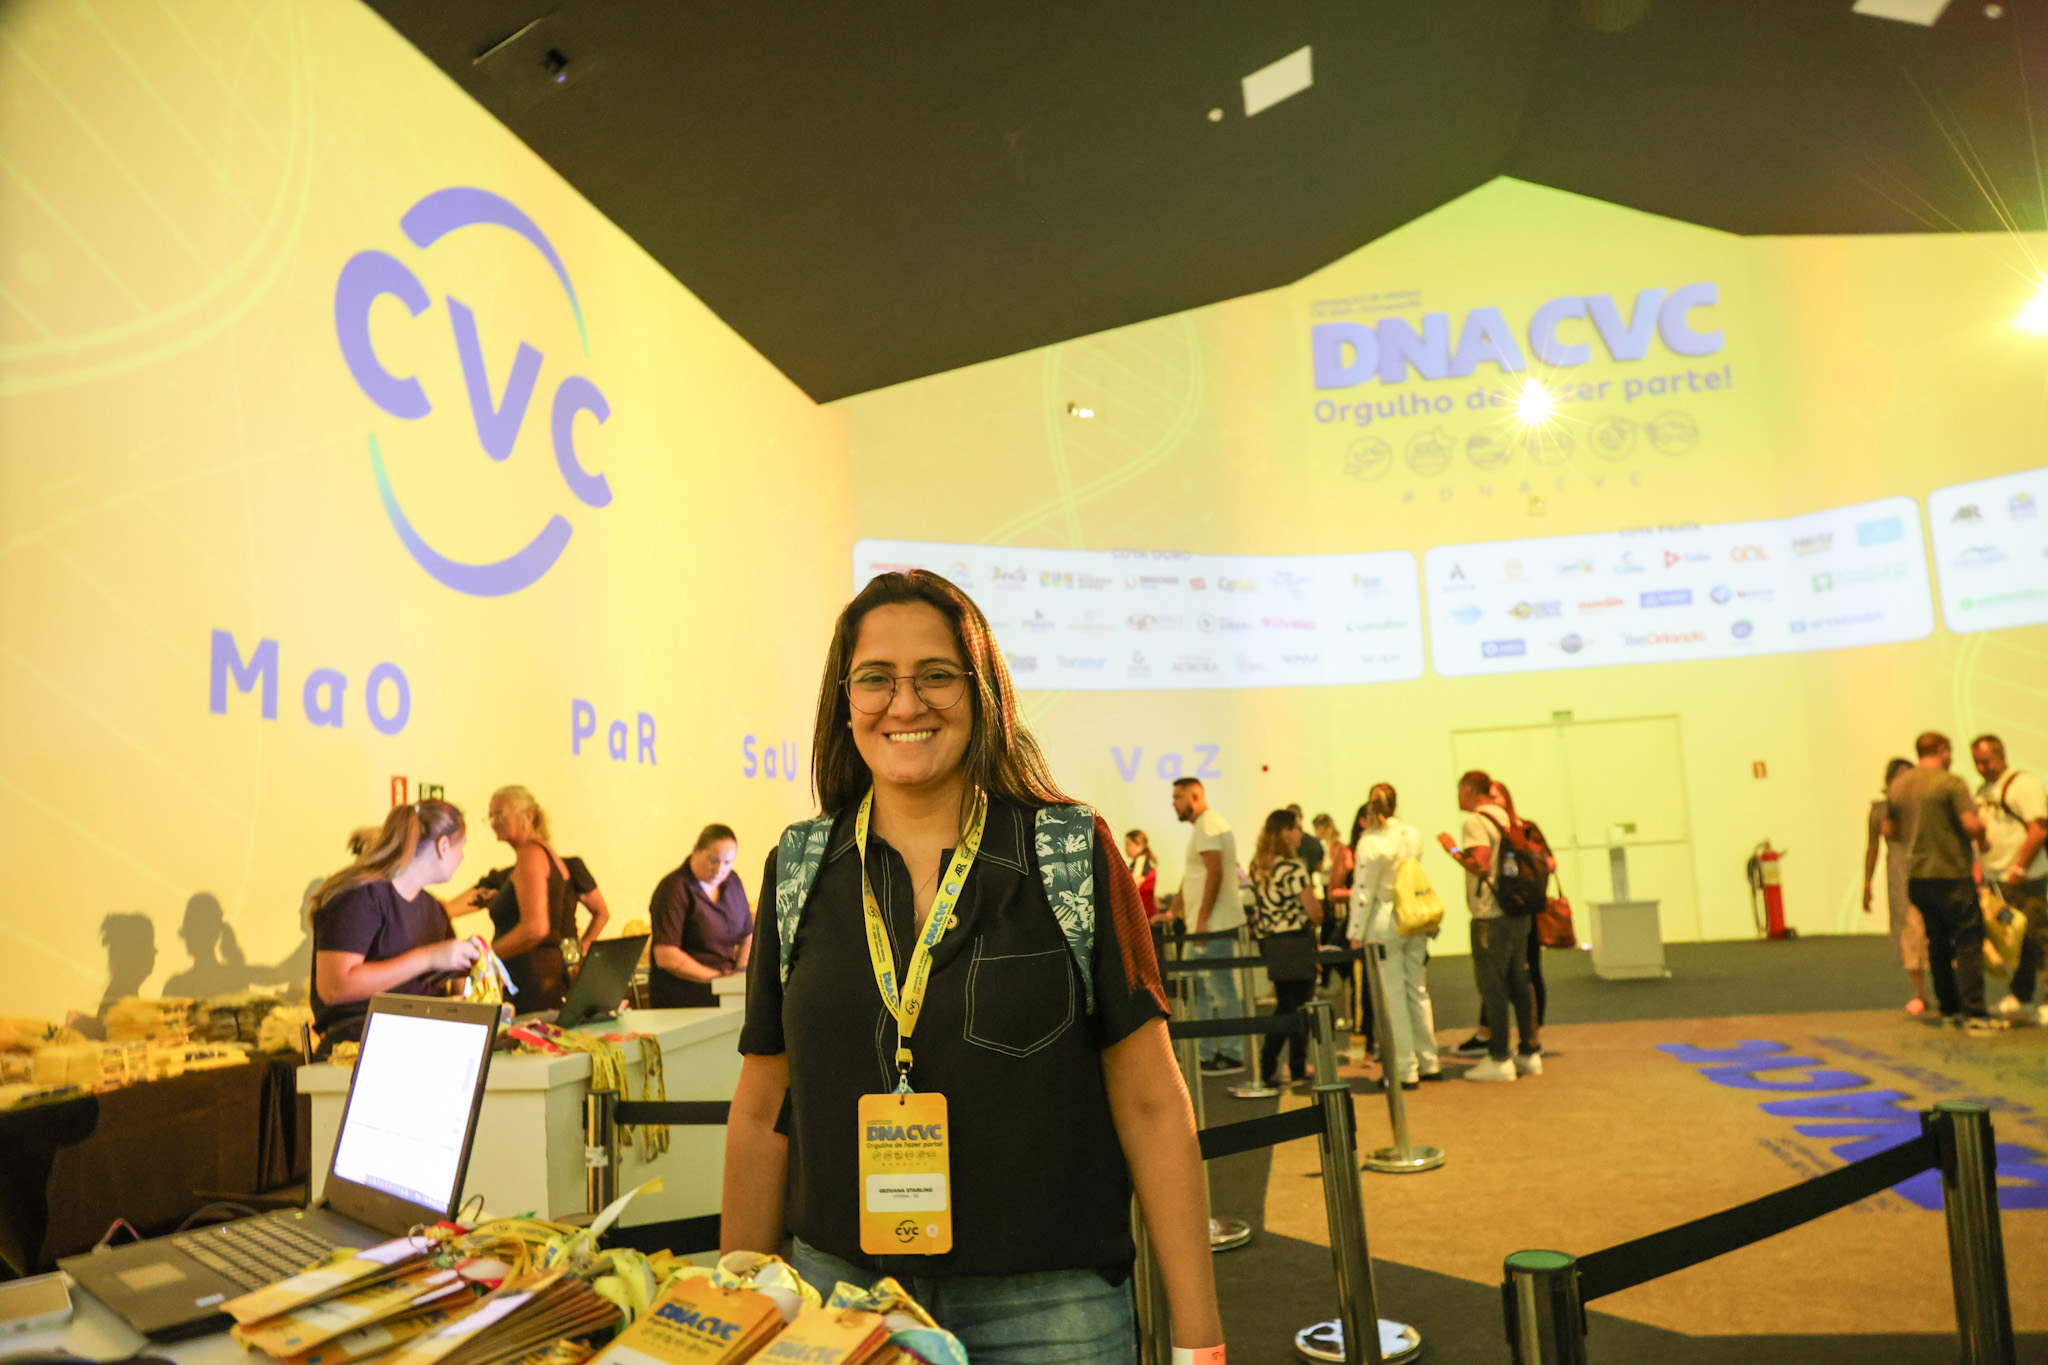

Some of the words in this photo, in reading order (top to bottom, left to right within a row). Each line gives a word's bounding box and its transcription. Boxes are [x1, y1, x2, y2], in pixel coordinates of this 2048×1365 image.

[1311, 307, 1527, 390] DNA
[1529, 282, 1726, 367] CVC
[334, 249, 613, 508] CVC
[1313, 391, 1454, 427] Orgulho
[1465, 386, 1507, 411] de
[1624, 364, 1733, 402] parte!
[1730, 545, 1769, 563] GOL
[209, 628, 411, 736] MaO
[571, 698, 657, 766] PaR
[742, 734, 799, 782] SaU
[1110, 743, 1223, 783] VaZ
[867, 1126, 906, 1141] DNA
[907, 1124, 942, 1140] CVC
[895, 1226, 919, 1236] CVC
[697, 1317, 742, 1341] CVC
